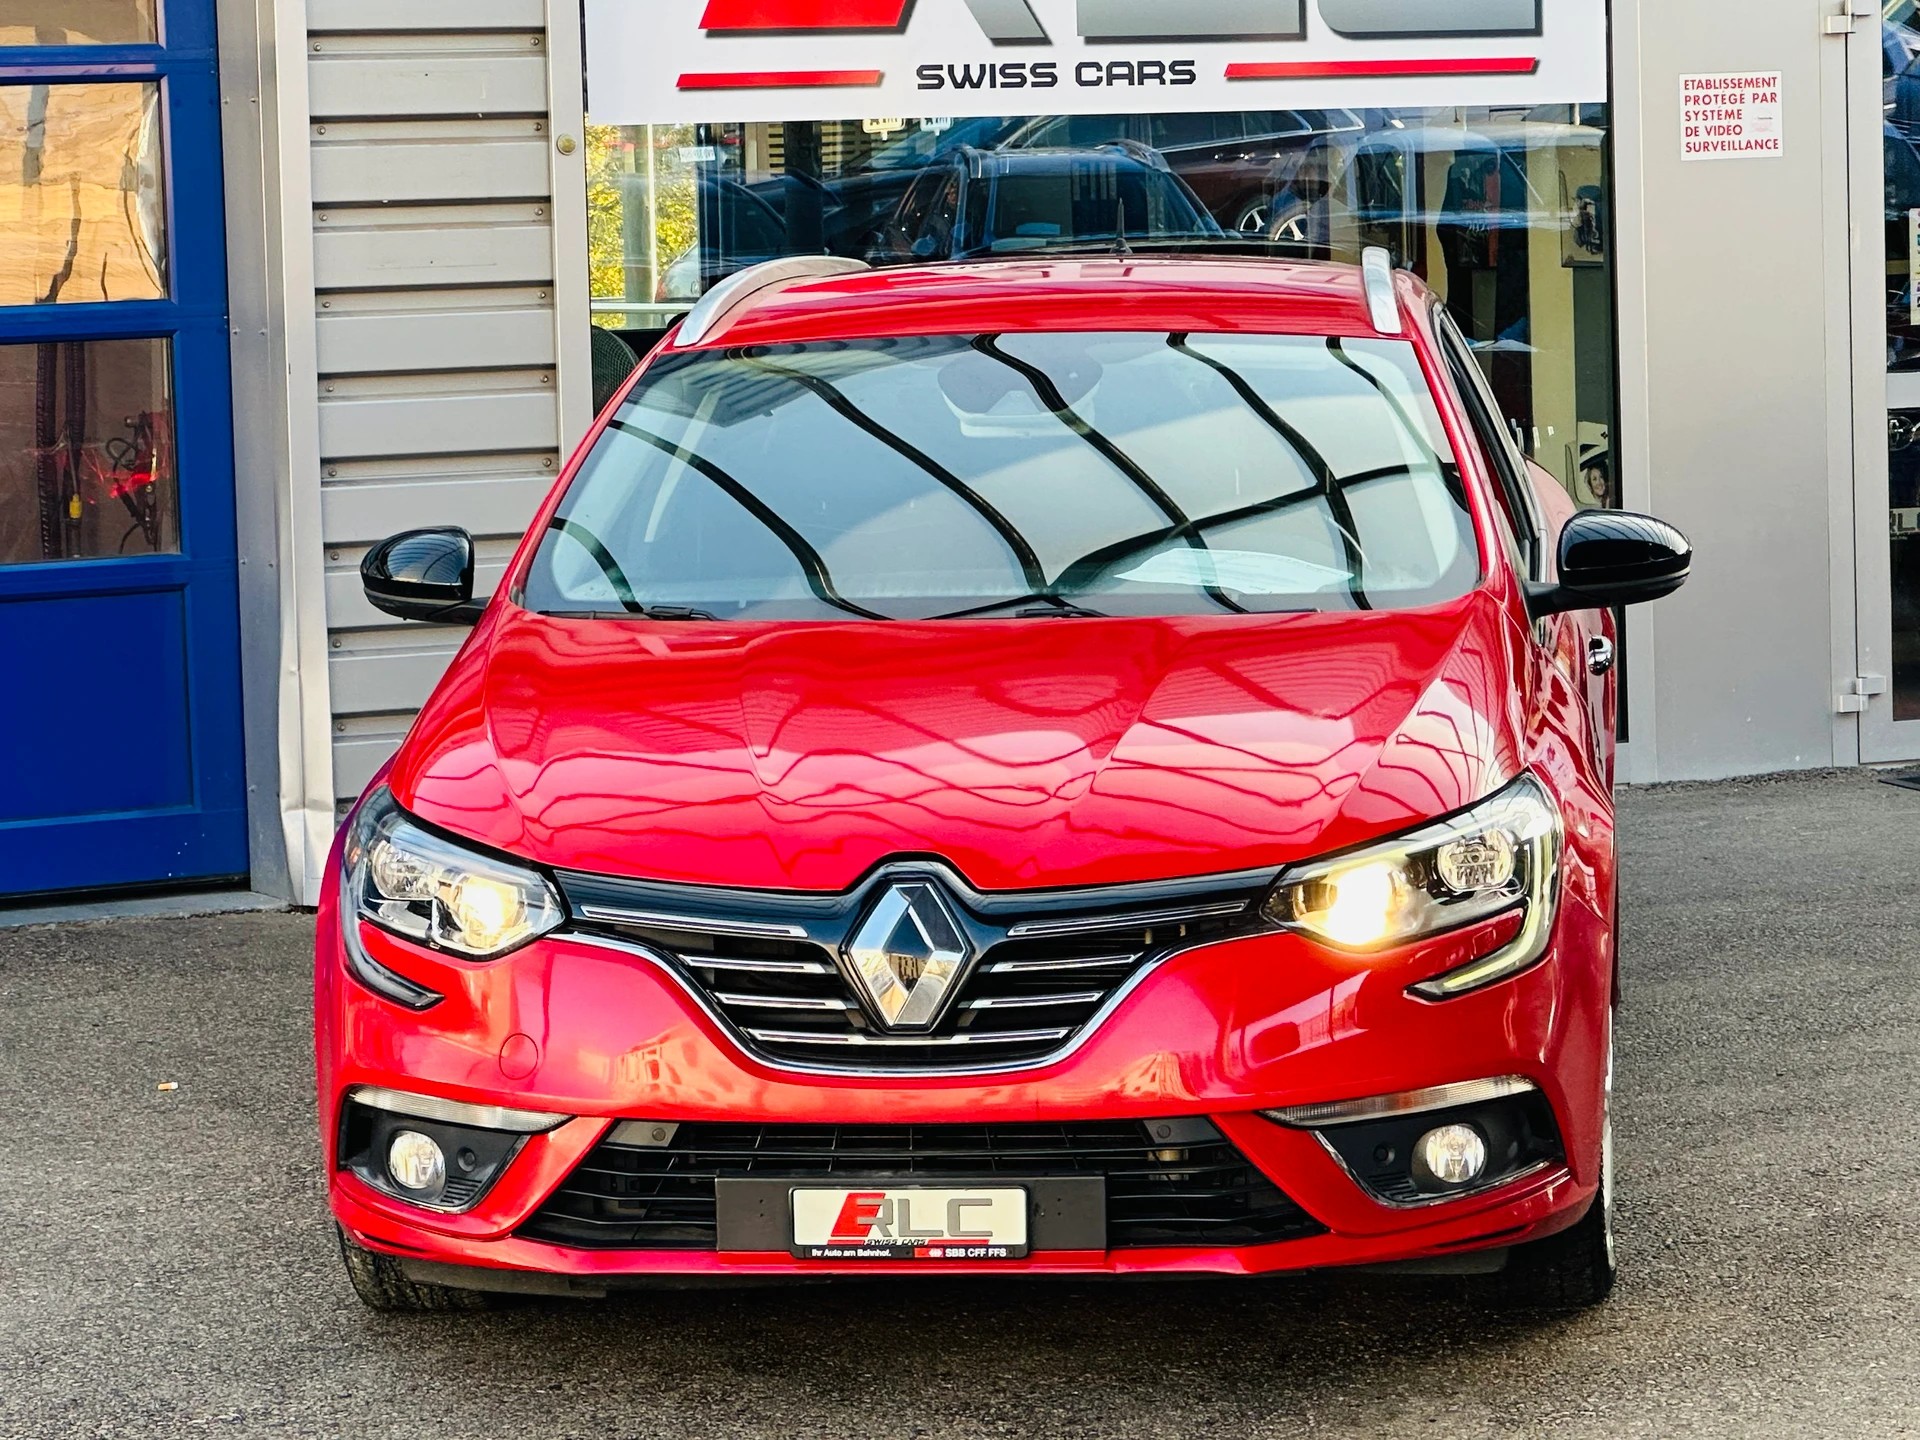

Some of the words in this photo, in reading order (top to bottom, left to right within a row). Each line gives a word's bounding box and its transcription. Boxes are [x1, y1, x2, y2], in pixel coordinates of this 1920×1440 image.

[916, 62, 1058, 90] SWISS
[1075, 60, 1197, 87] CARS
[1684, 76, 1778, 91] ETABLISSEMENT
[1752, 92, 1778, 104] PAR
[1685, 126, 1700, 138] DE
[1685, 138, 1779, 153] SURVEILLANCE
[811, 1248, 823, 1257] Ihr
[823, 1248, 842, 1257] Auto
[945, 1248, 966, 1258] SBB
[967, 1248, 987, 1258] CFF
[988, 1248, 1007, 1258] FFS
